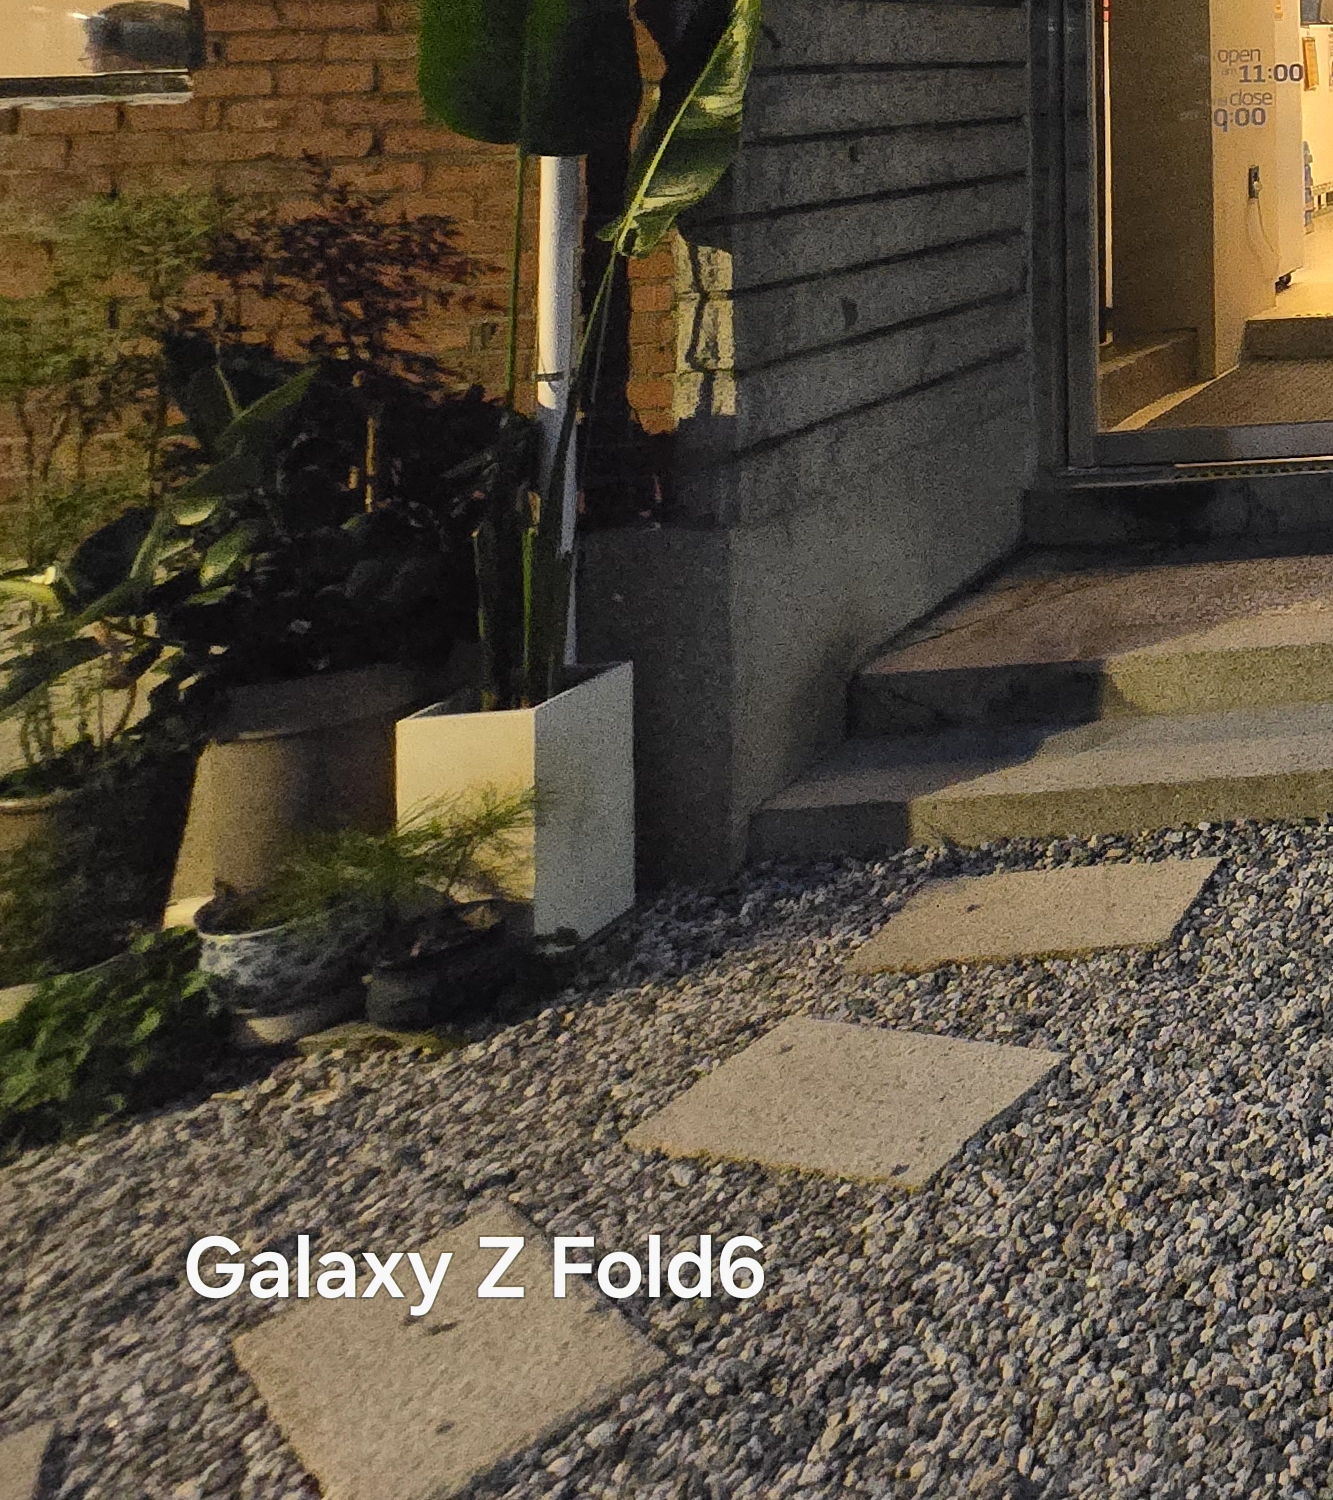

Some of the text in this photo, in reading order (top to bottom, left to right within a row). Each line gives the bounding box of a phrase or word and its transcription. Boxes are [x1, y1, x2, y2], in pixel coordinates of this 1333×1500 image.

[1217, 48, 1261, 66] open
[1239, 63, 1304, 83] 11:00
[1229, 88, 1273, 106] close
